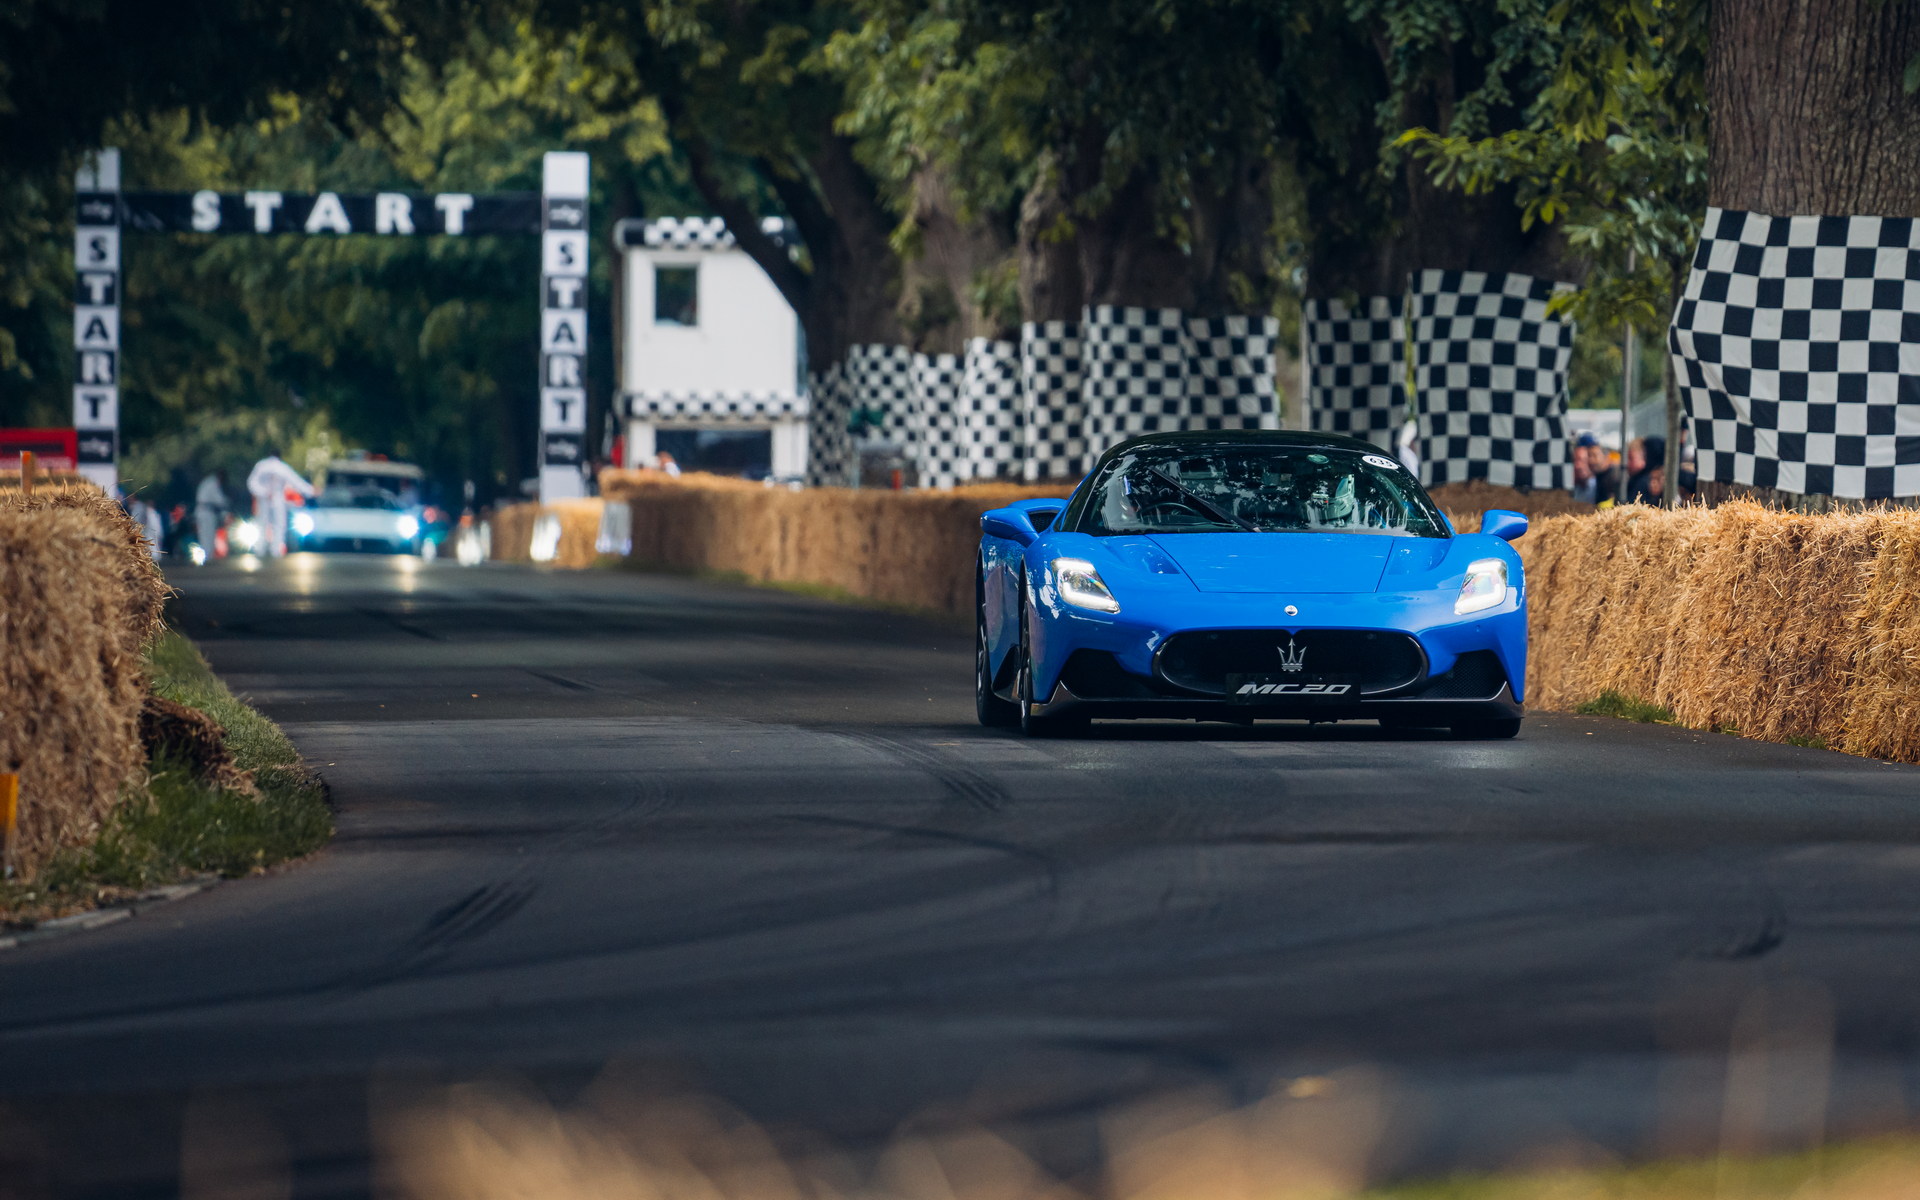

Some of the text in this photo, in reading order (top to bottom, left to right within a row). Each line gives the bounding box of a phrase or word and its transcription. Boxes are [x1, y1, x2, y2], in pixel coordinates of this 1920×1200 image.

[191, 189, 474, 235] START
[82, 235, 114, 420] START
[550, 240, 582, 423] START
[1236, 683, 1352, 695] MC20
